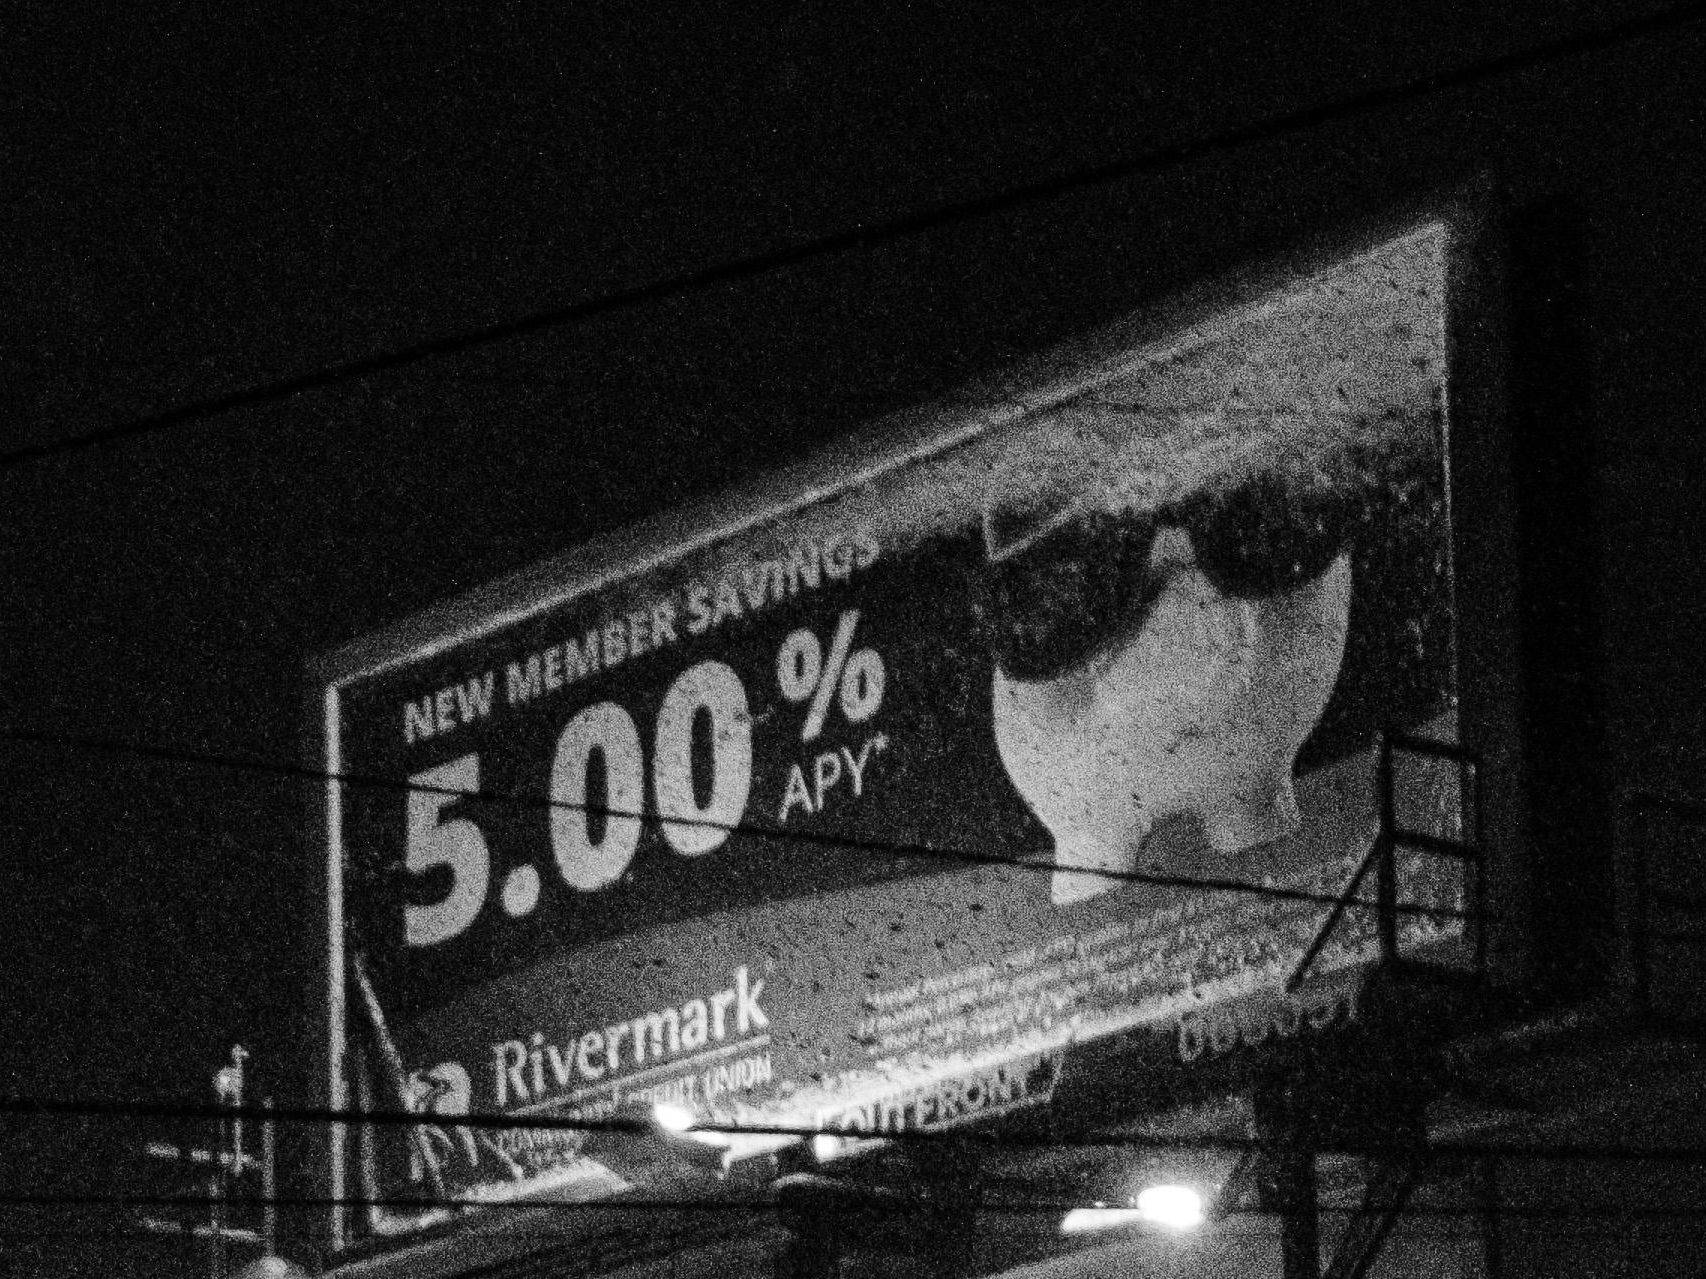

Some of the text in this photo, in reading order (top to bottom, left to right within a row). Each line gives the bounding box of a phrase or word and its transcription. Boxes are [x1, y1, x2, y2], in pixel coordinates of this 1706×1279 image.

[403, 533, 881, 746] NEW MEMBER SAVINGS
[491, 964, 771, 1108] Rivermark
